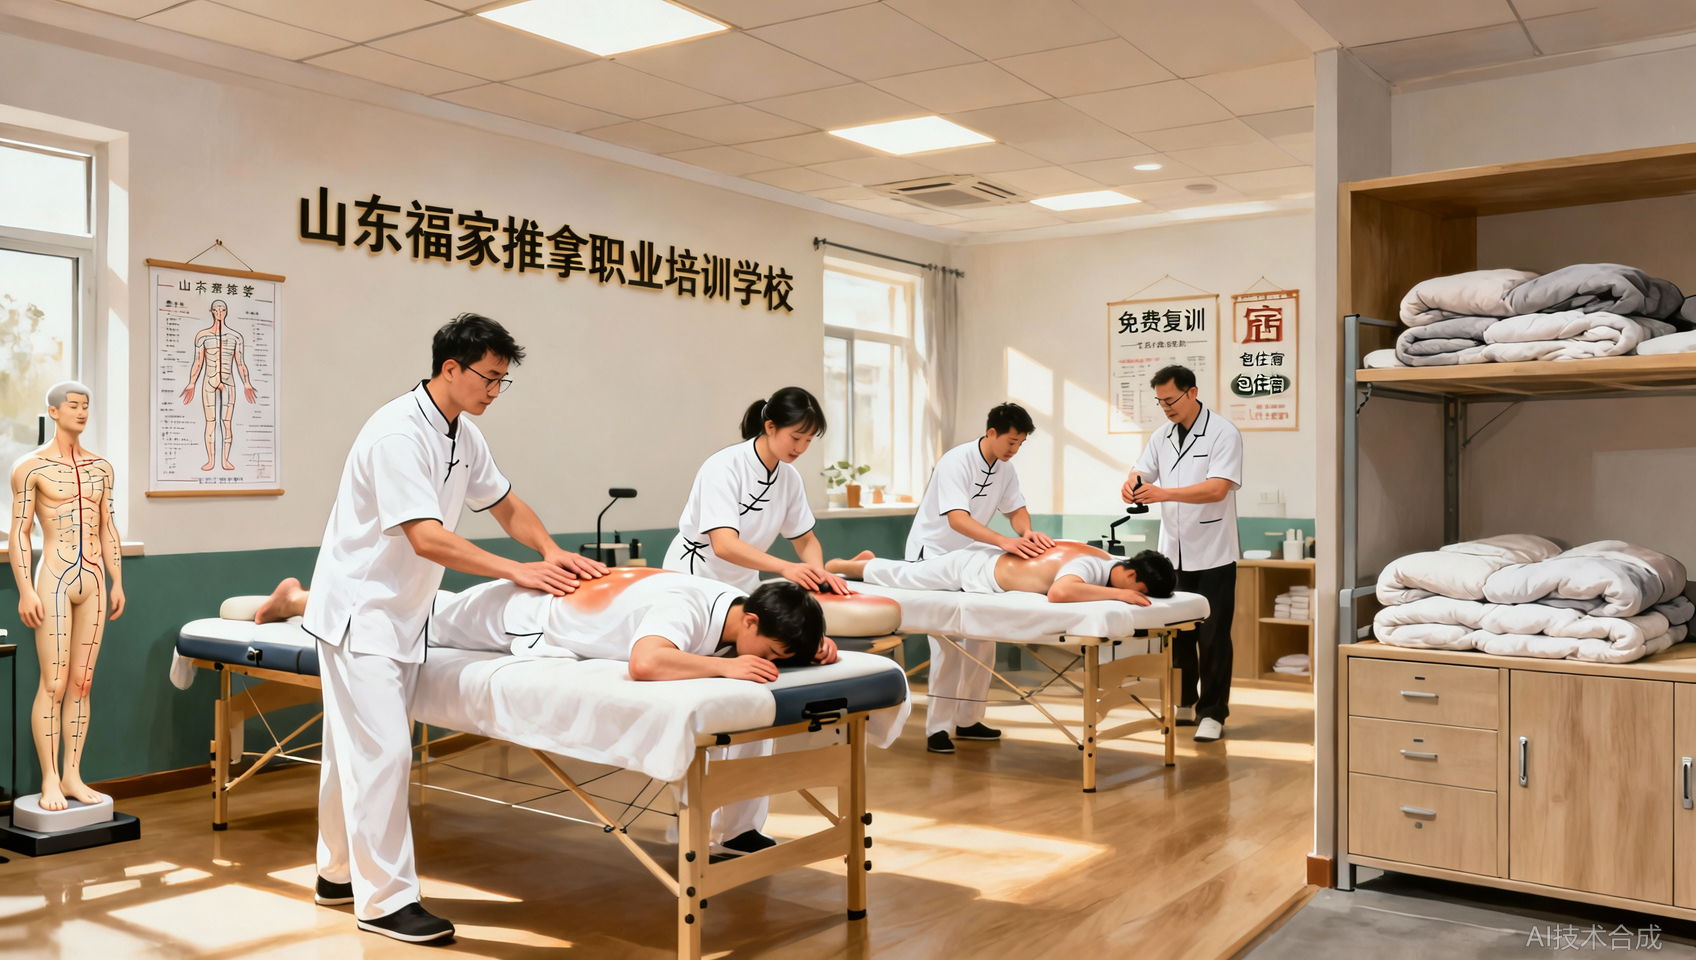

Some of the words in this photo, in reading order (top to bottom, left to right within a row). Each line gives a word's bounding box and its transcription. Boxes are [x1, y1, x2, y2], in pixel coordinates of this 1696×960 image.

[300, 187, 794, 312] 山东福家推拿职业培训学校
[1118, 307, 1205, 334] 免费复训
